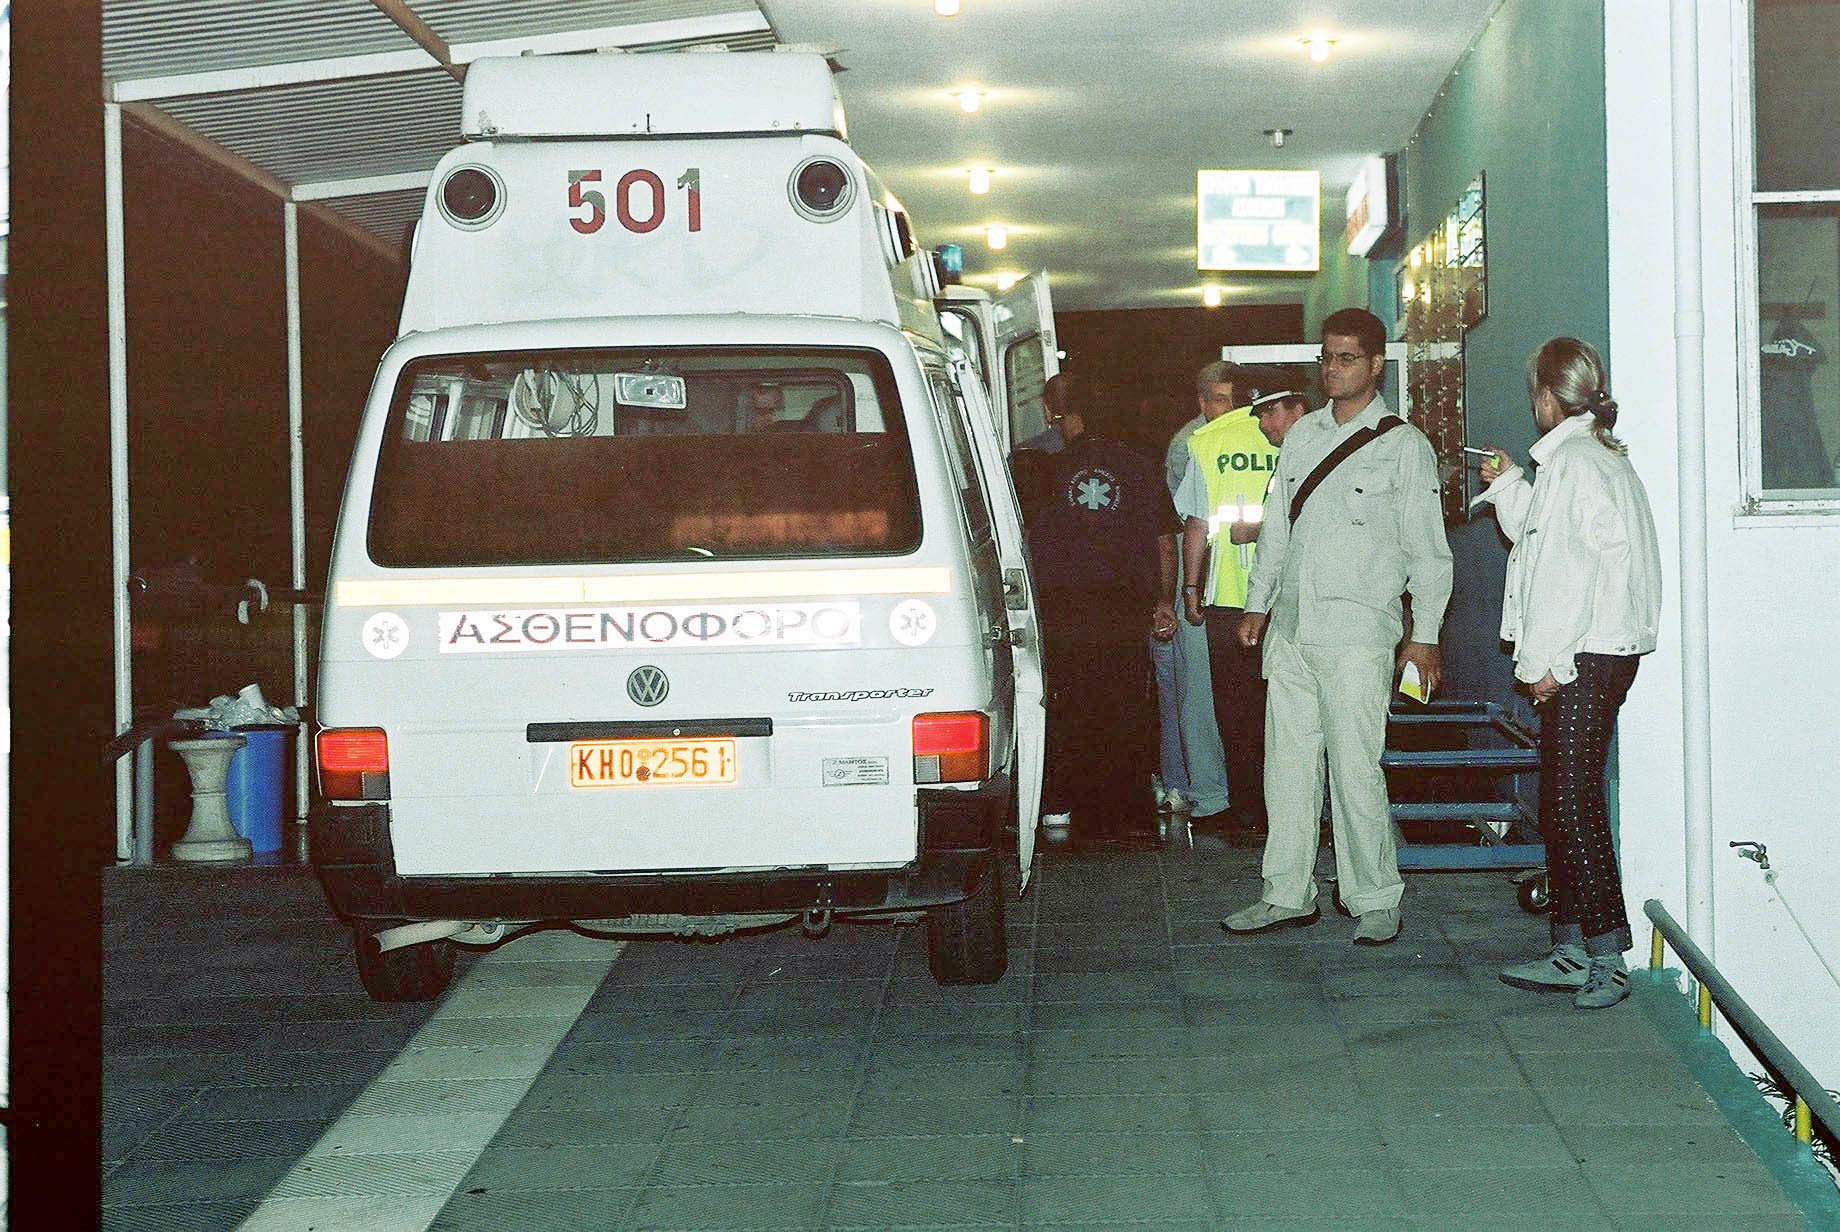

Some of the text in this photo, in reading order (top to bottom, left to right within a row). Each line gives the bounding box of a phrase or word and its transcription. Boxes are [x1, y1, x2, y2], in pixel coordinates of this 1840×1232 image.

[568, 168, 701, 234] 501
[1217, 452, 1279, 474] POLI
[449, 607, 850, 645] ΑΣΘΕΝΟΦΟΡΟ
[788, 688, 934, 702] Transporter
[652, 747, 725, 778] 2561
